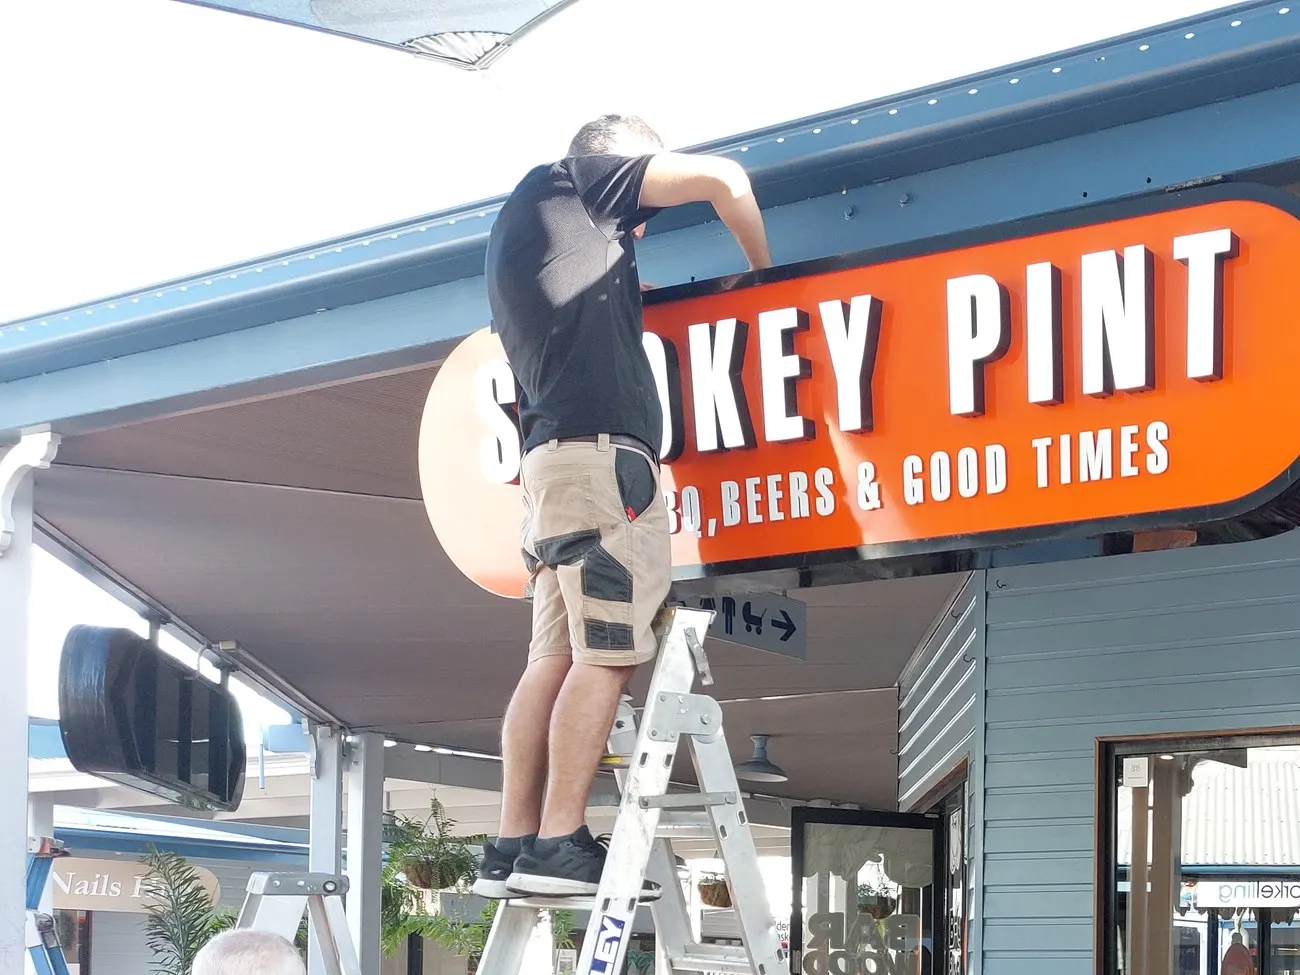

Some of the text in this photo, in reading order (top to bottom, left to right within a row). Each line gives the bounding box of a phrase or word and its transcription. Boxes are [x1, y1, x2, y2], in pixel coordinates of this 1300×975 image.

[946, 228, 1238, 418] PINT
[857, 461, 881, 510] &
[903, 443, 1007, 505] GOOD
[1031, 421, 1170, 487] TIMES
[53, 871, 122, 898] Nails
